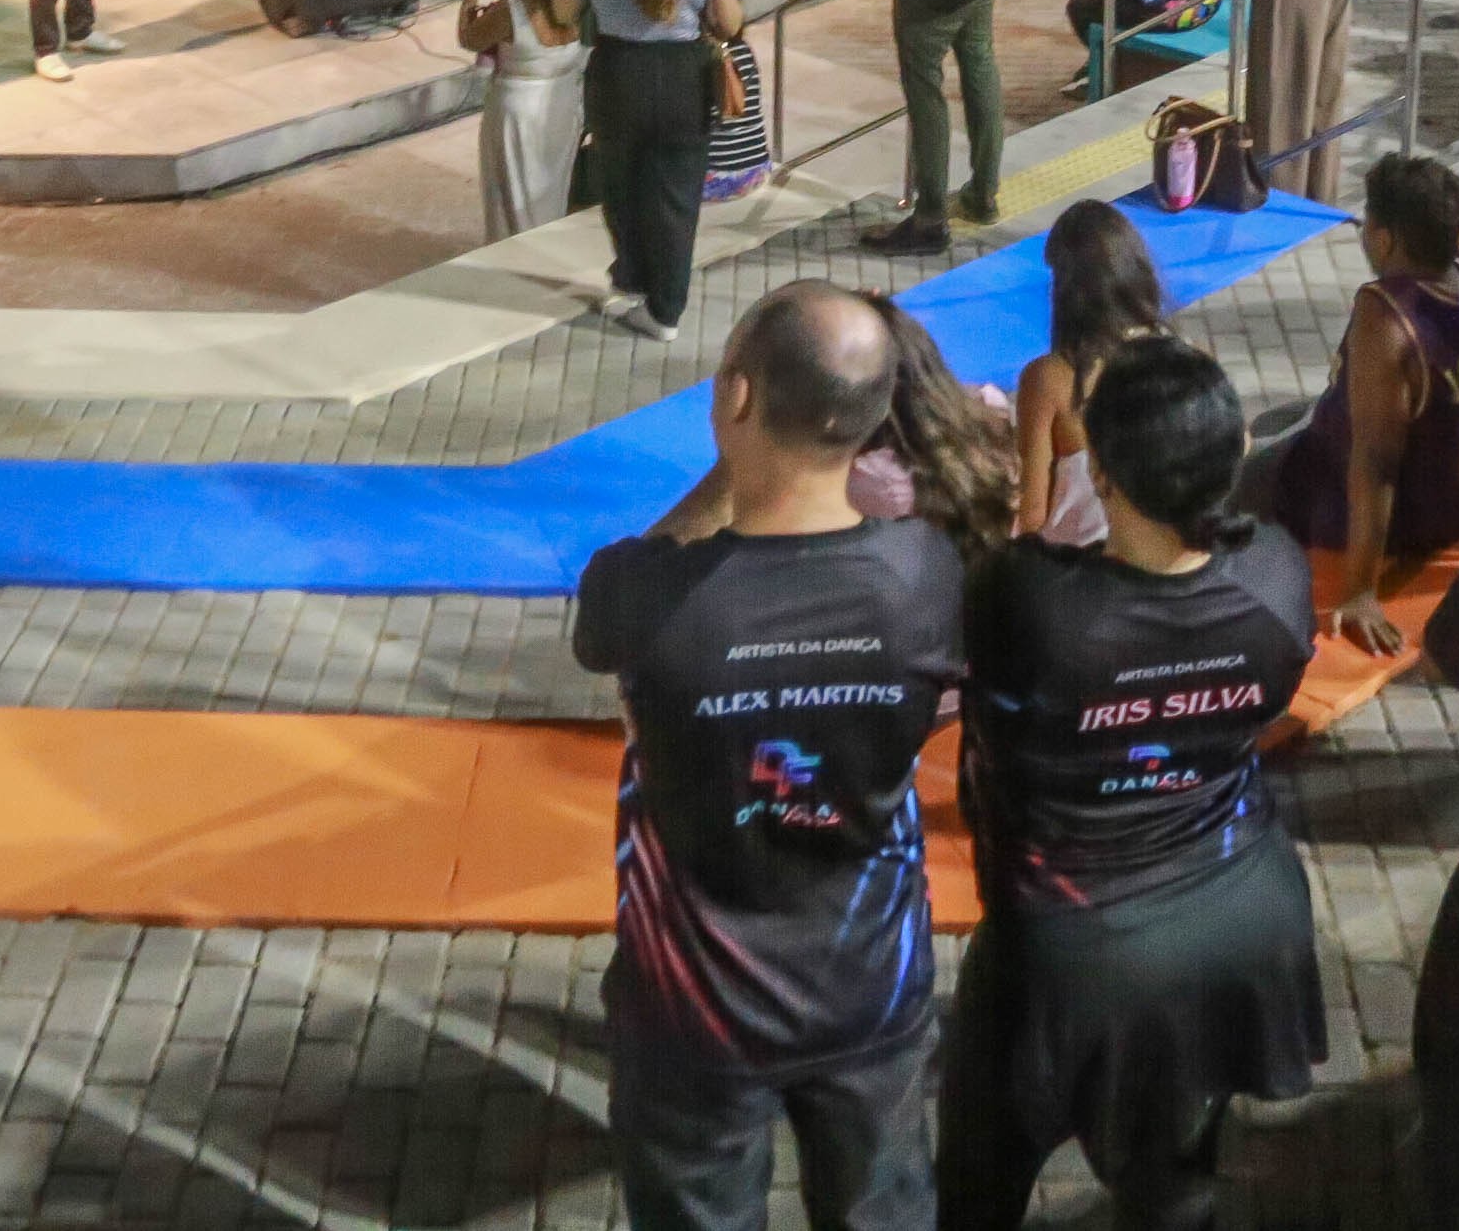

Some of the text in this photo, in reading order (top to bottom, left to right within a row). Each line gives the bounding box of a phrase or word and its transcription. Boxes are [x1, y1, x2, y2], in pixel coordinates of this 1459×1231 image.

[726, 643, 795, 661] ARTISTA
[798, 641, 822, 654] DA
[695, 685, 905, 716] ALEX MARTINS
[1078, 683, 1264, 733] IRIS SILVA
